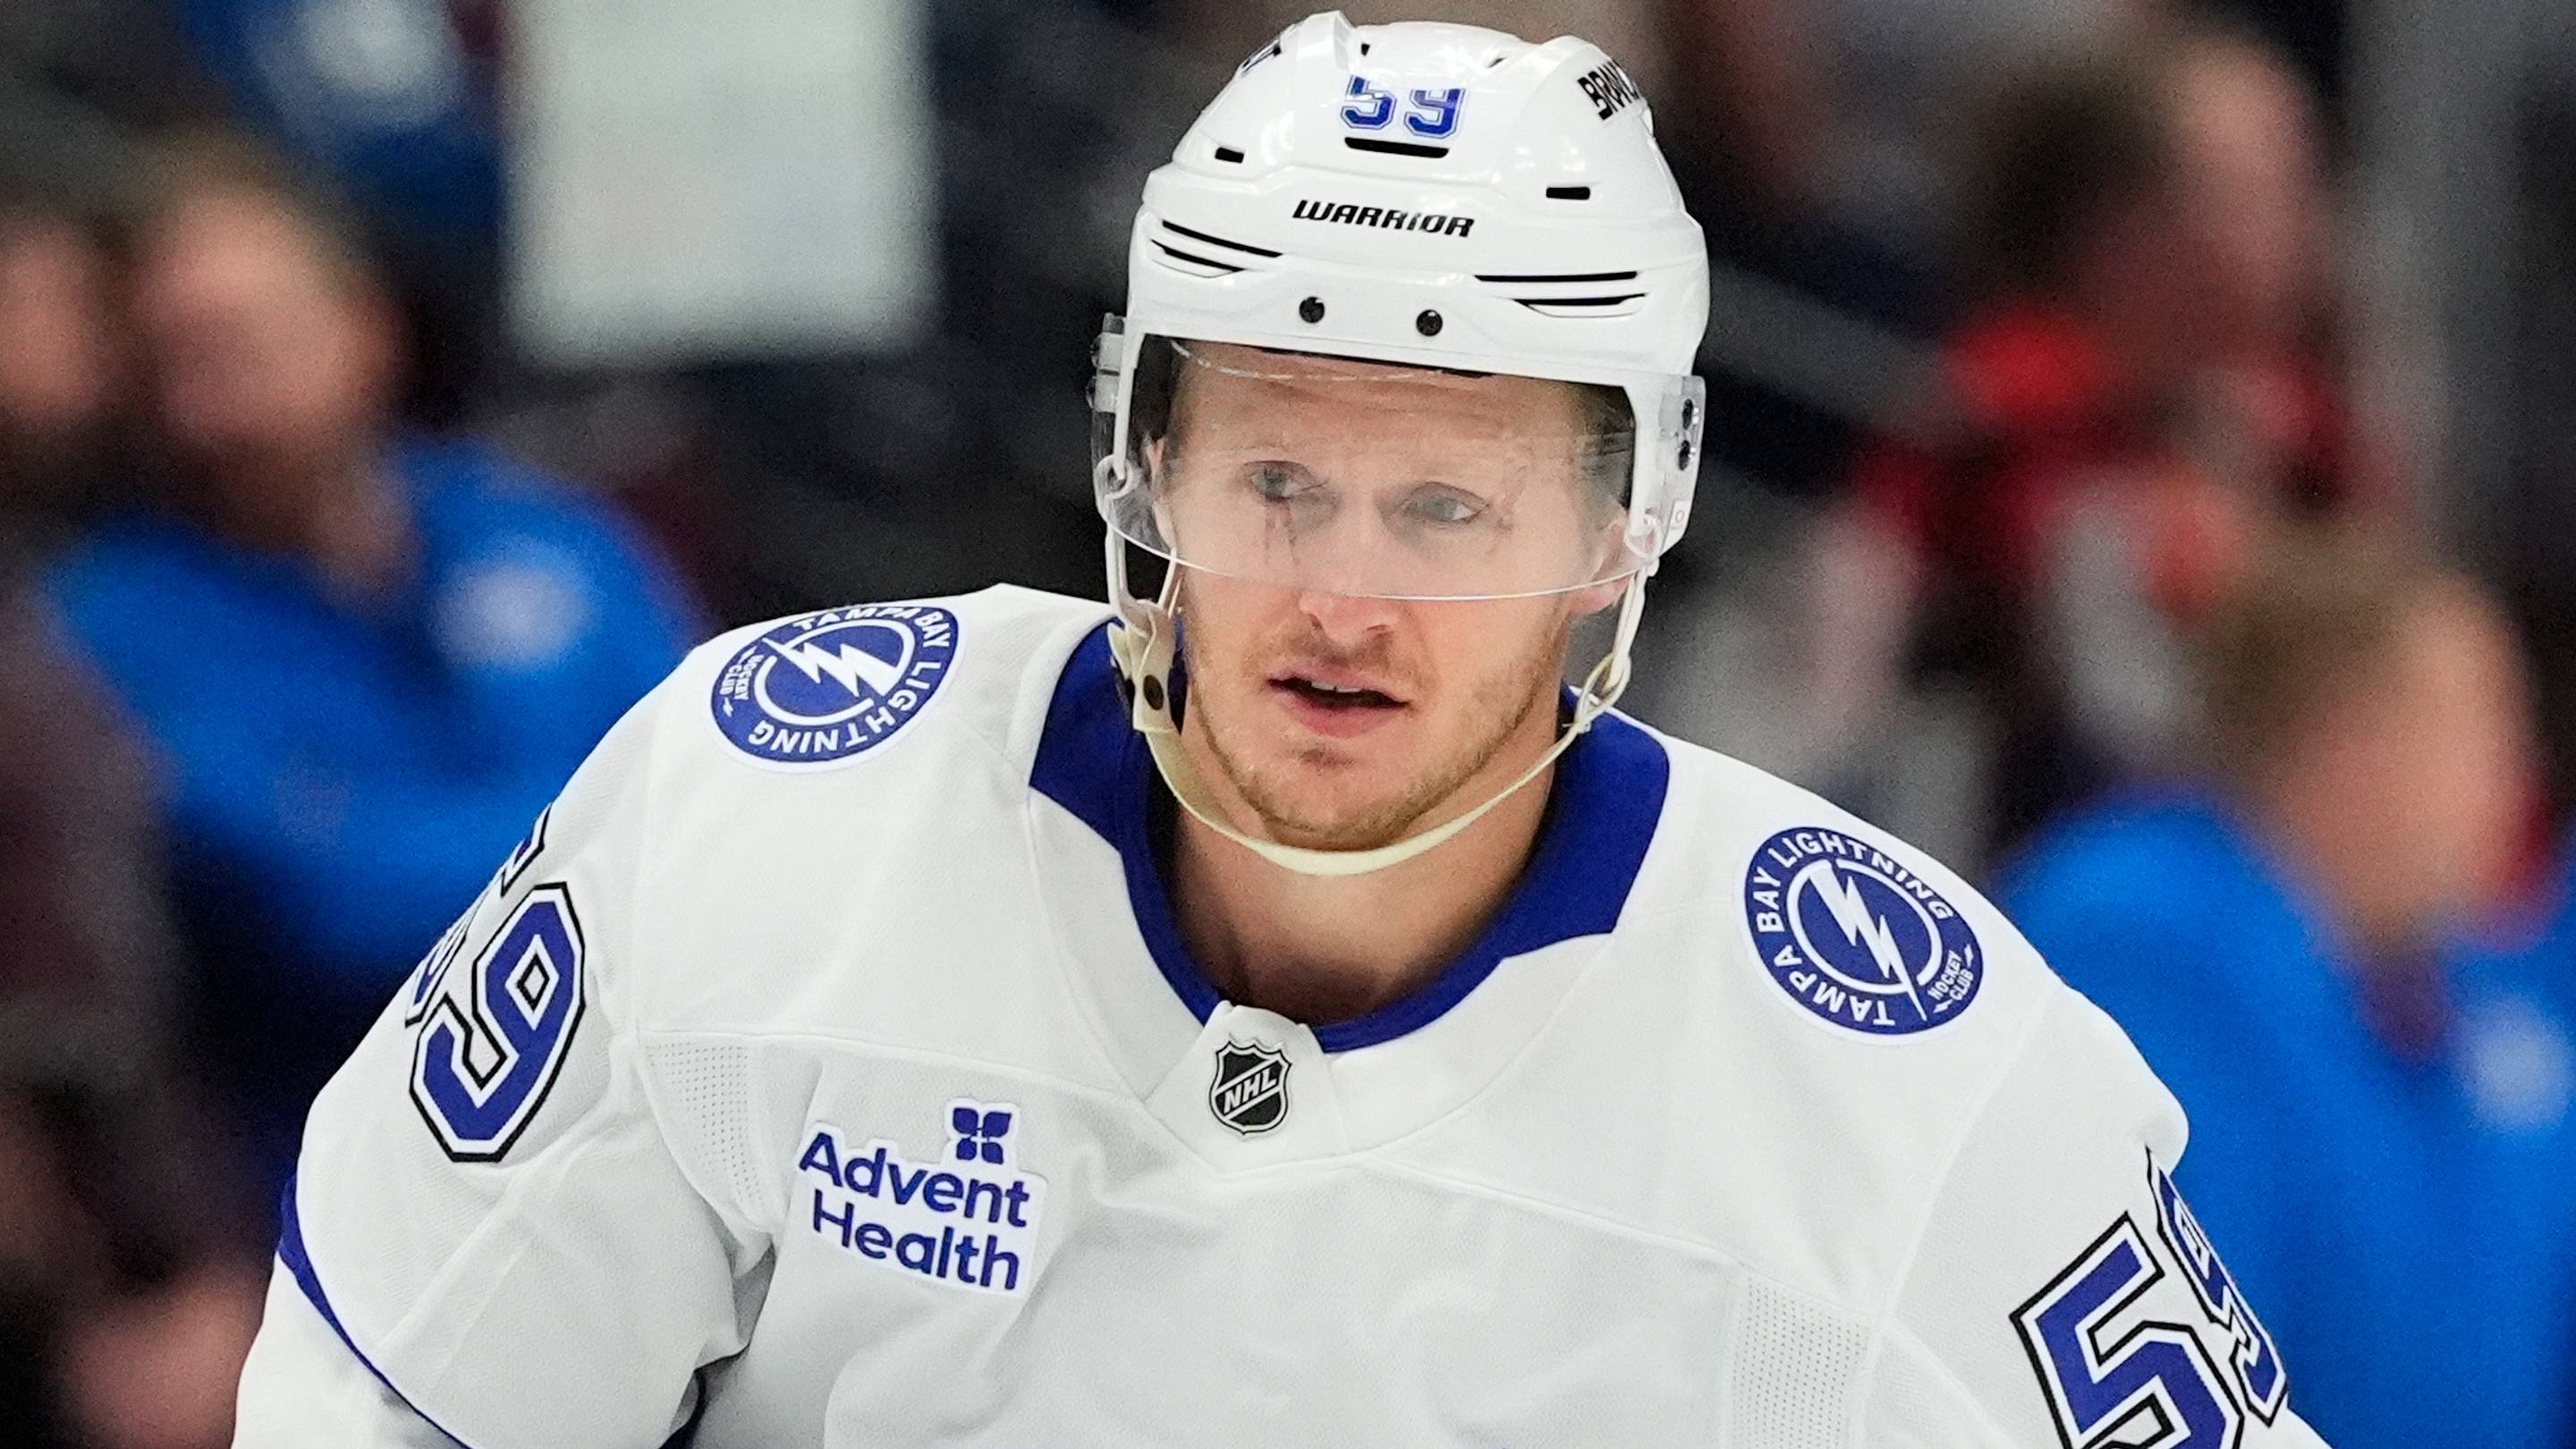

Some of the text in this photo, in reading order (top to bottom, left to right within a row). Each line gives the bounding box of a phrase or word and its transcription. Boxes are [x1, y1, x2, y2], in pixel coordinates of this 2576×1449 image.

[1340, 74, 1467, 140] 59
[1292, 199, 1475, 238] WARRIOR
[748, 607, 951, 753] TAMPA BAY LIGHTNING
[1752, 832, 1953, 1026] TAMPA BAY LIGHTNING
[1928, 950, 1962, 1001] HOCKEY
[1949, 967, 1975, 1002] CLUB
[1224, 1067, 1277, 1115] NHL
[799, 1131, 1030, 1228] Advent
[812, 1189, 1020, 1291] Health
[2009, 1145, 2288, 1449] 59
